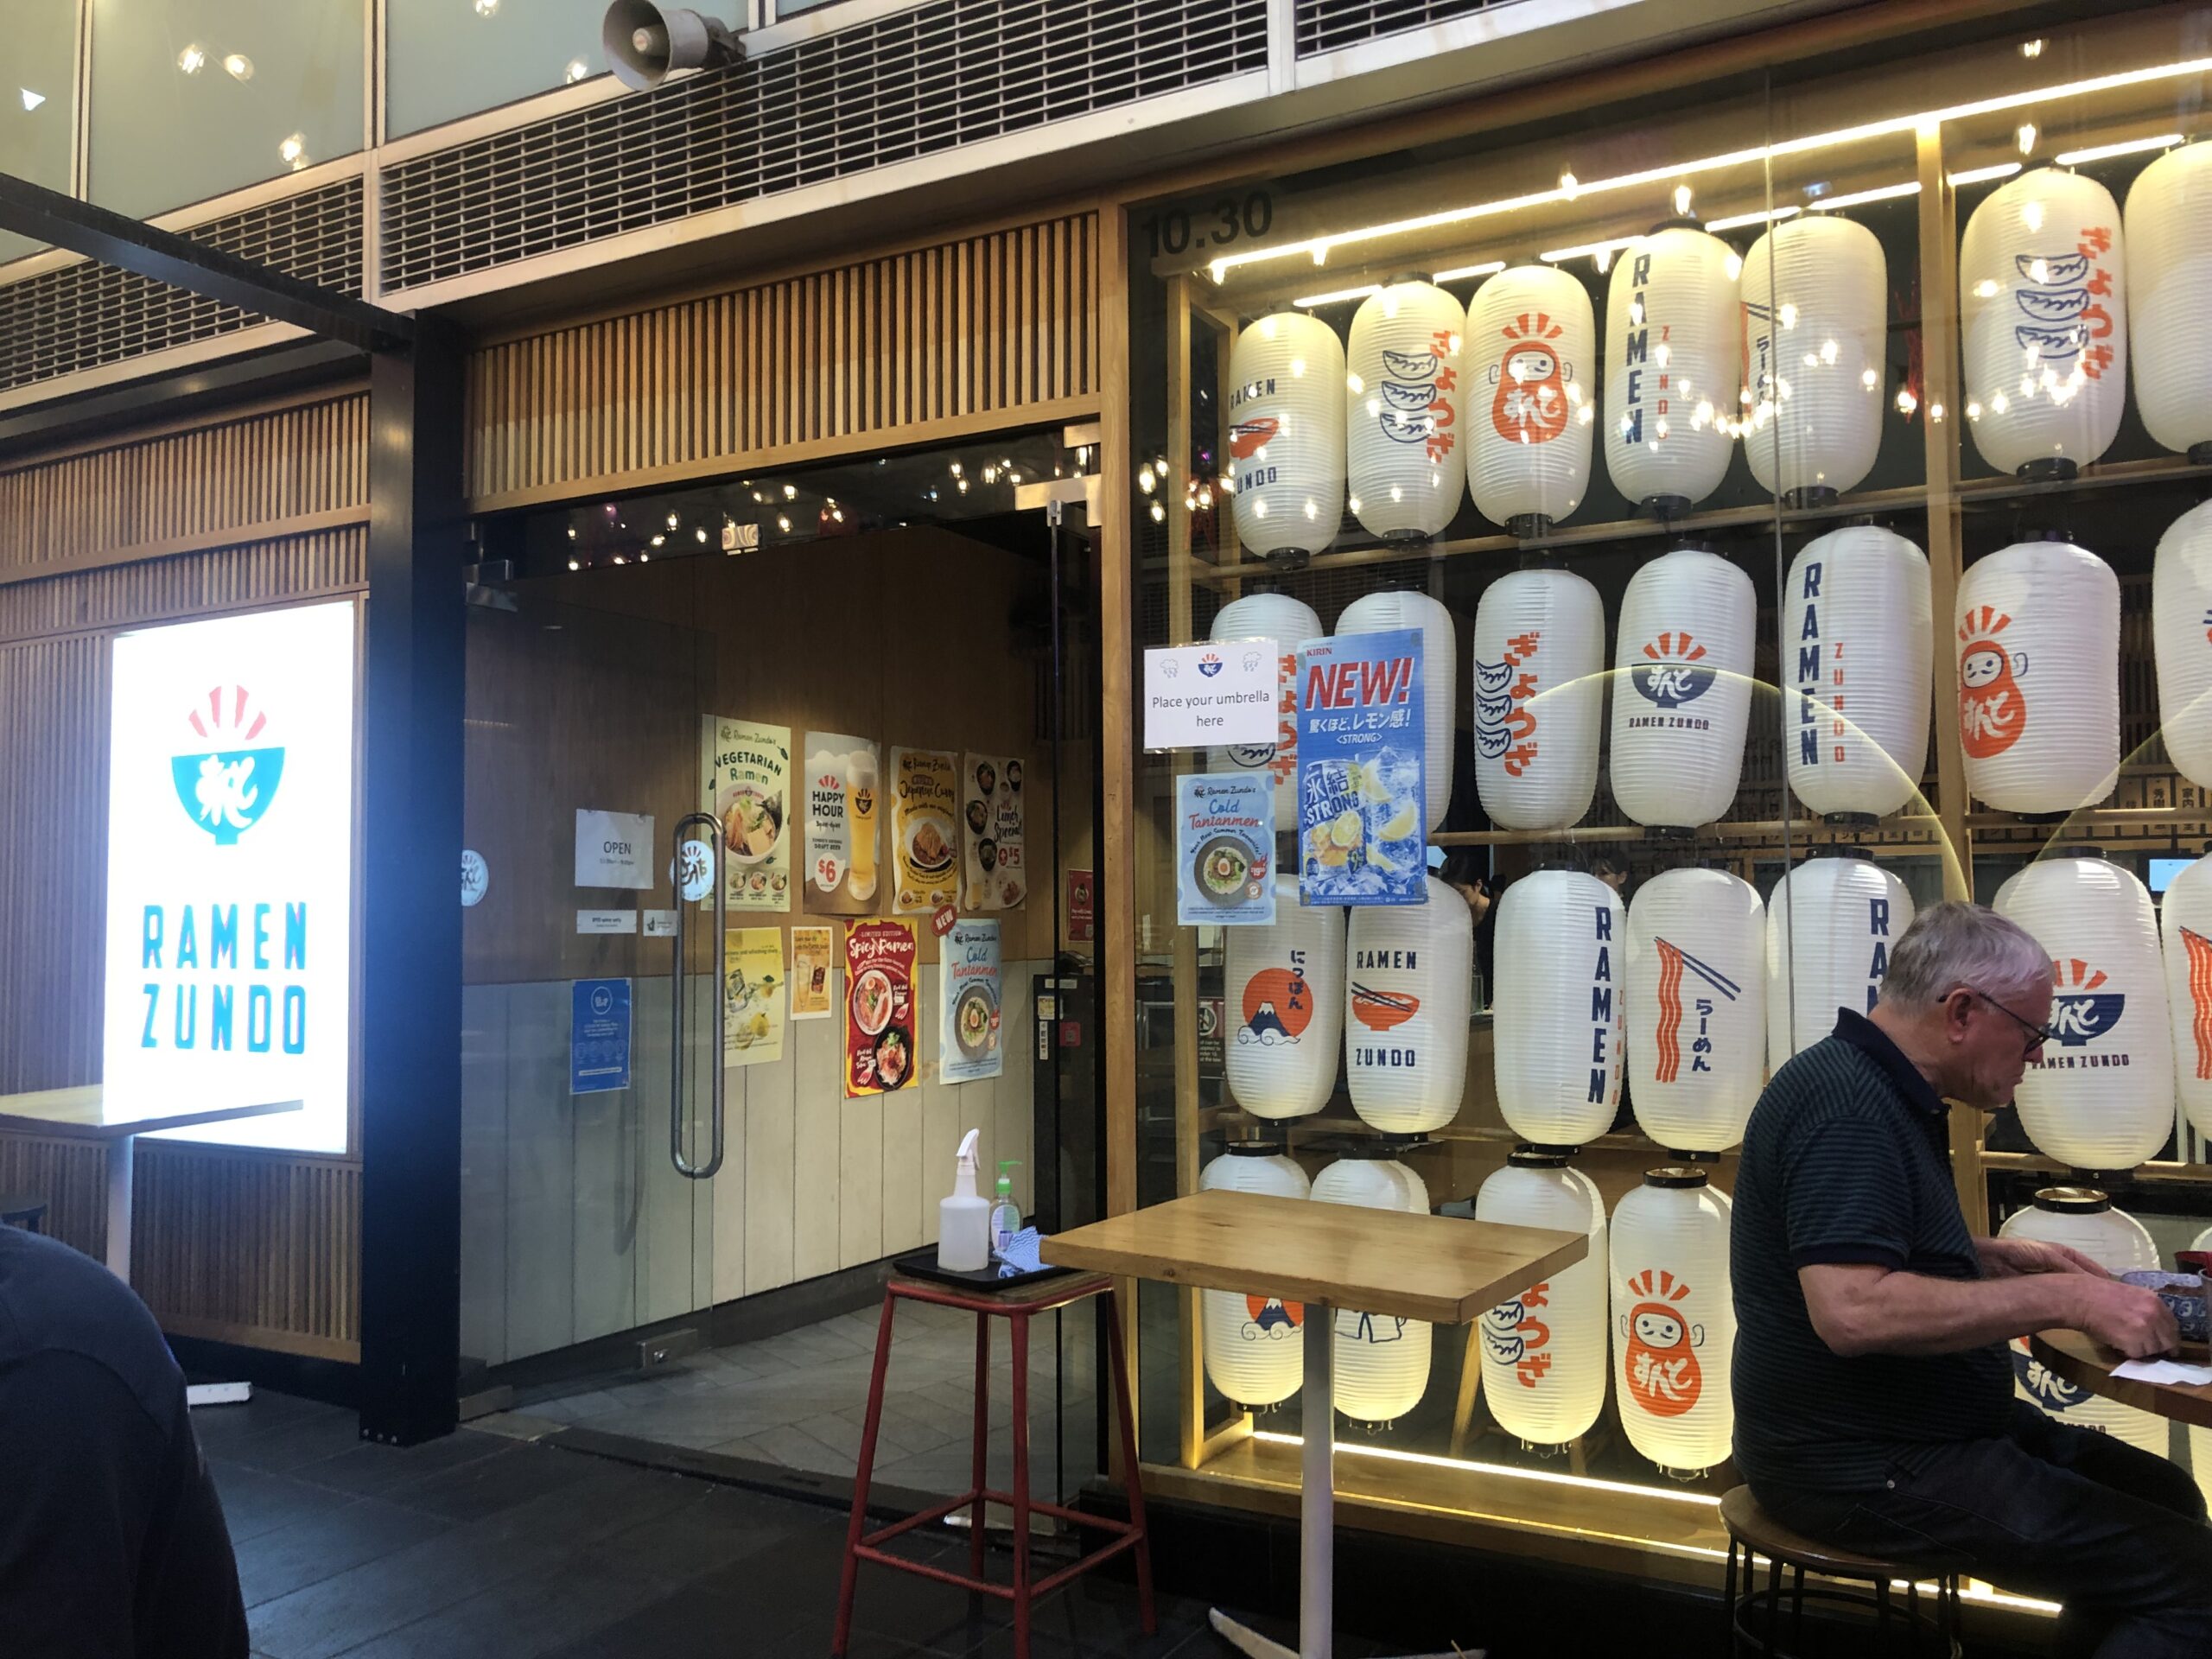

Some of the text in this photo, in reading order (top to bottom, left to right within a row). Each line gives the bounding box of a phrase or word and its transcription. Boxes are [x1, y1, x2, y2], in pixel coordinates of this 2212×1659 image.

[1143, 190, 1273, 258] 10.30
[1233, 466, 1277, 499] UNDO
[1306, 647, 1333, 658] KIRIN
[1798, 562, 1822, 766] RAMEN
[1305, 657, 1415, 712] NEW!
[1152, 690, 1270, 709] Place your umbrella
[1503, 632, 1541, 777] ぎょうざ
[1833, 642, 1845, 763] ZUNDO
[1196, 715, 1224, 728] here
[1629, 716, 1710, 731] RAMEN ZUNDO
[715, 751, 782, 777] VEGETARIAN
[729, 766, 769, 786] Ramen
[1306, 768, 1350, 804] 氷結
[812, 790, 845, 804] HAPPY
[1209, 798, 1241, 815] Cold
[1306, 790, 1360, 825] STRONG
[812, 804, 844, 819] HOUR
[995, 804, 1019, 823] Lunch
[1188, 812, 1261, 831] Tantanmen
[603, 840, 632, 855] OPEN
[817, 858, 836, 883] $6
[935, 908, 954, 931] NEW
[141, 900, 308, 970] RAMEN
[849, 937, 875, 960] Spicy
[878, 937, 914, 956] Ramen
[966, 945, 988, 963] Cold
[1356, 950, 1417, 969] RAMEN
[1587, 906, 1612, 1105] RAMEN
[140, 982, 308, 1055] ZUNDO
[1691, 998, 1713, 1072] らーめん
[1356, 1048, 1416, 1068] ZUNDO
[2080, 1053, 2131, 1068] ZUNDO
